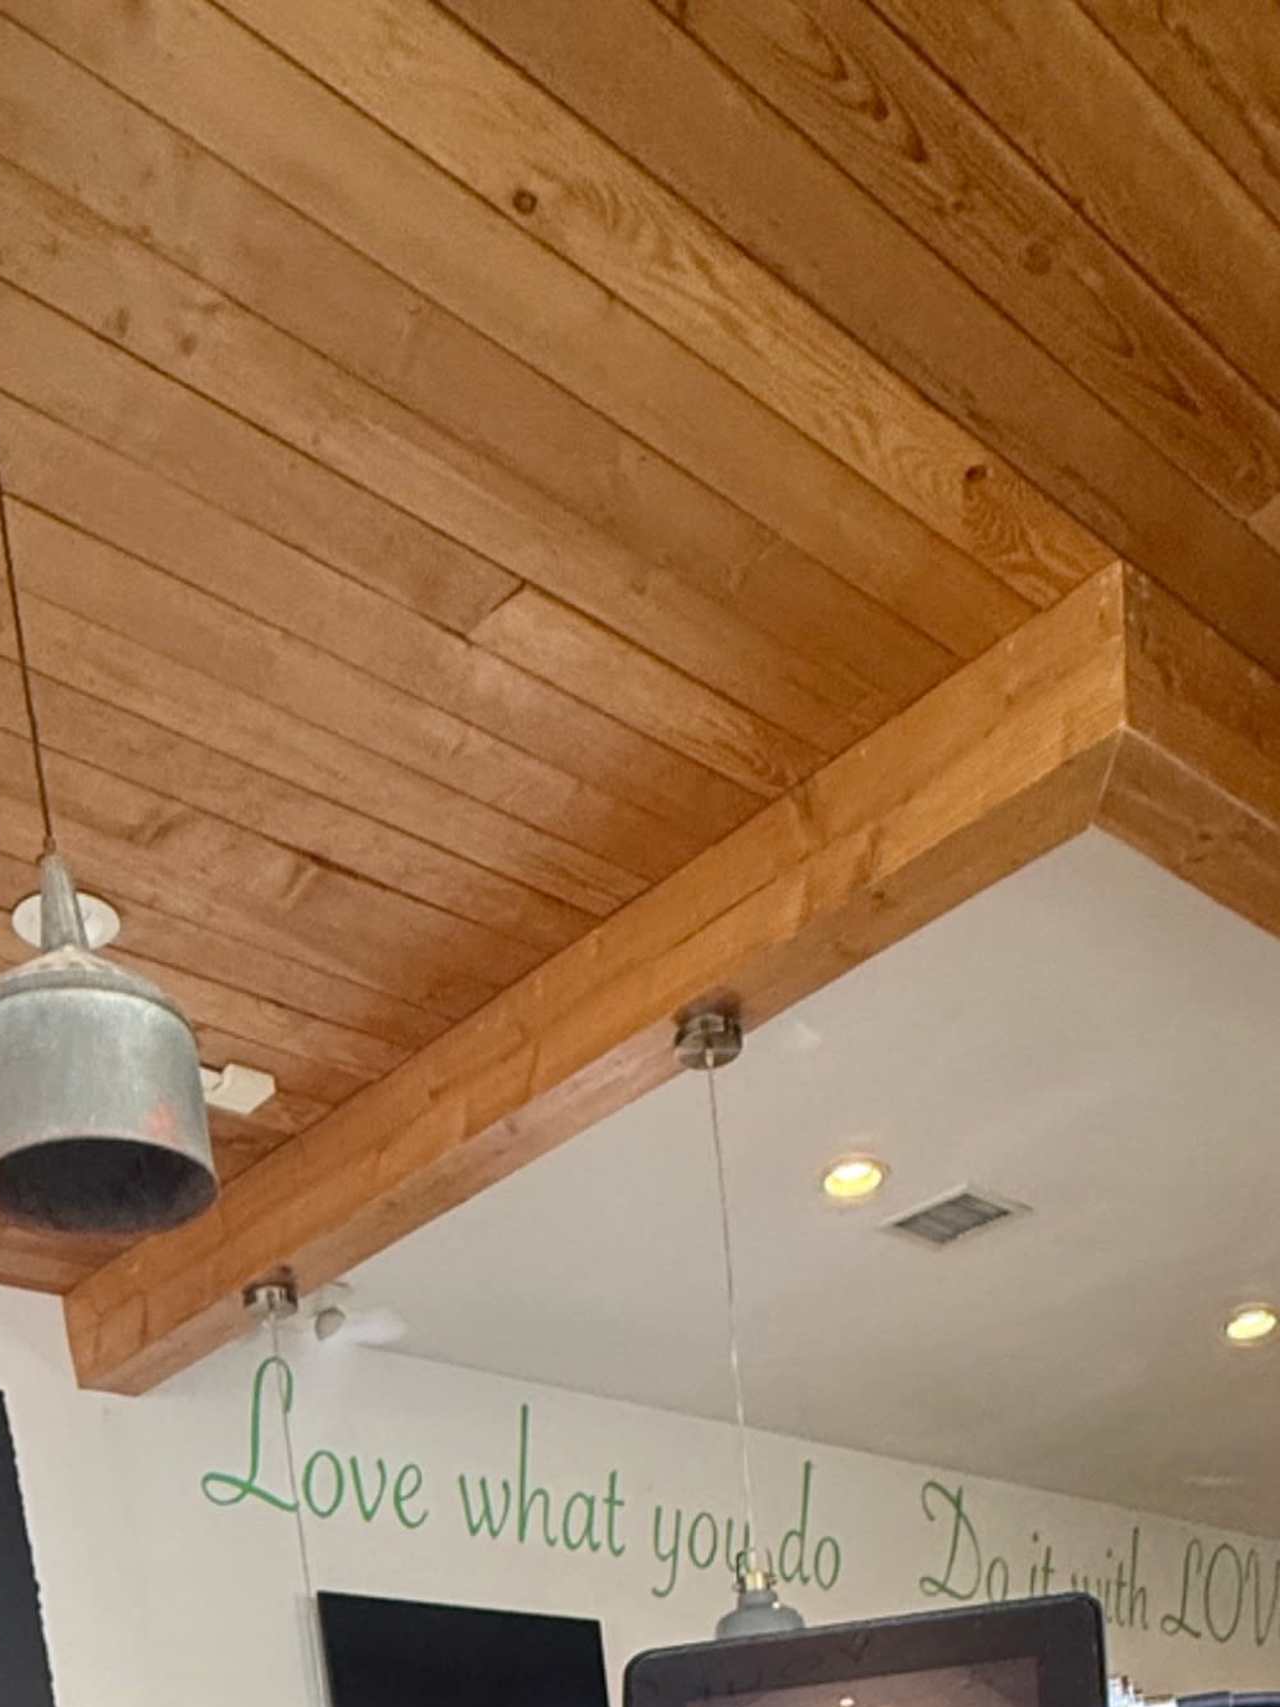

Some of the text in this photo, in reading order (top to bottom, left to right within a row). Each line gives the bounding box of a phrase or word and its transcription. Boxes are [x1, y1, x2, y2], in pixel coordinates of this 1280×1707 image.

[202, 1357, 842, 1598] Love what you do
[920, 1481, 1009, 1601] Do
